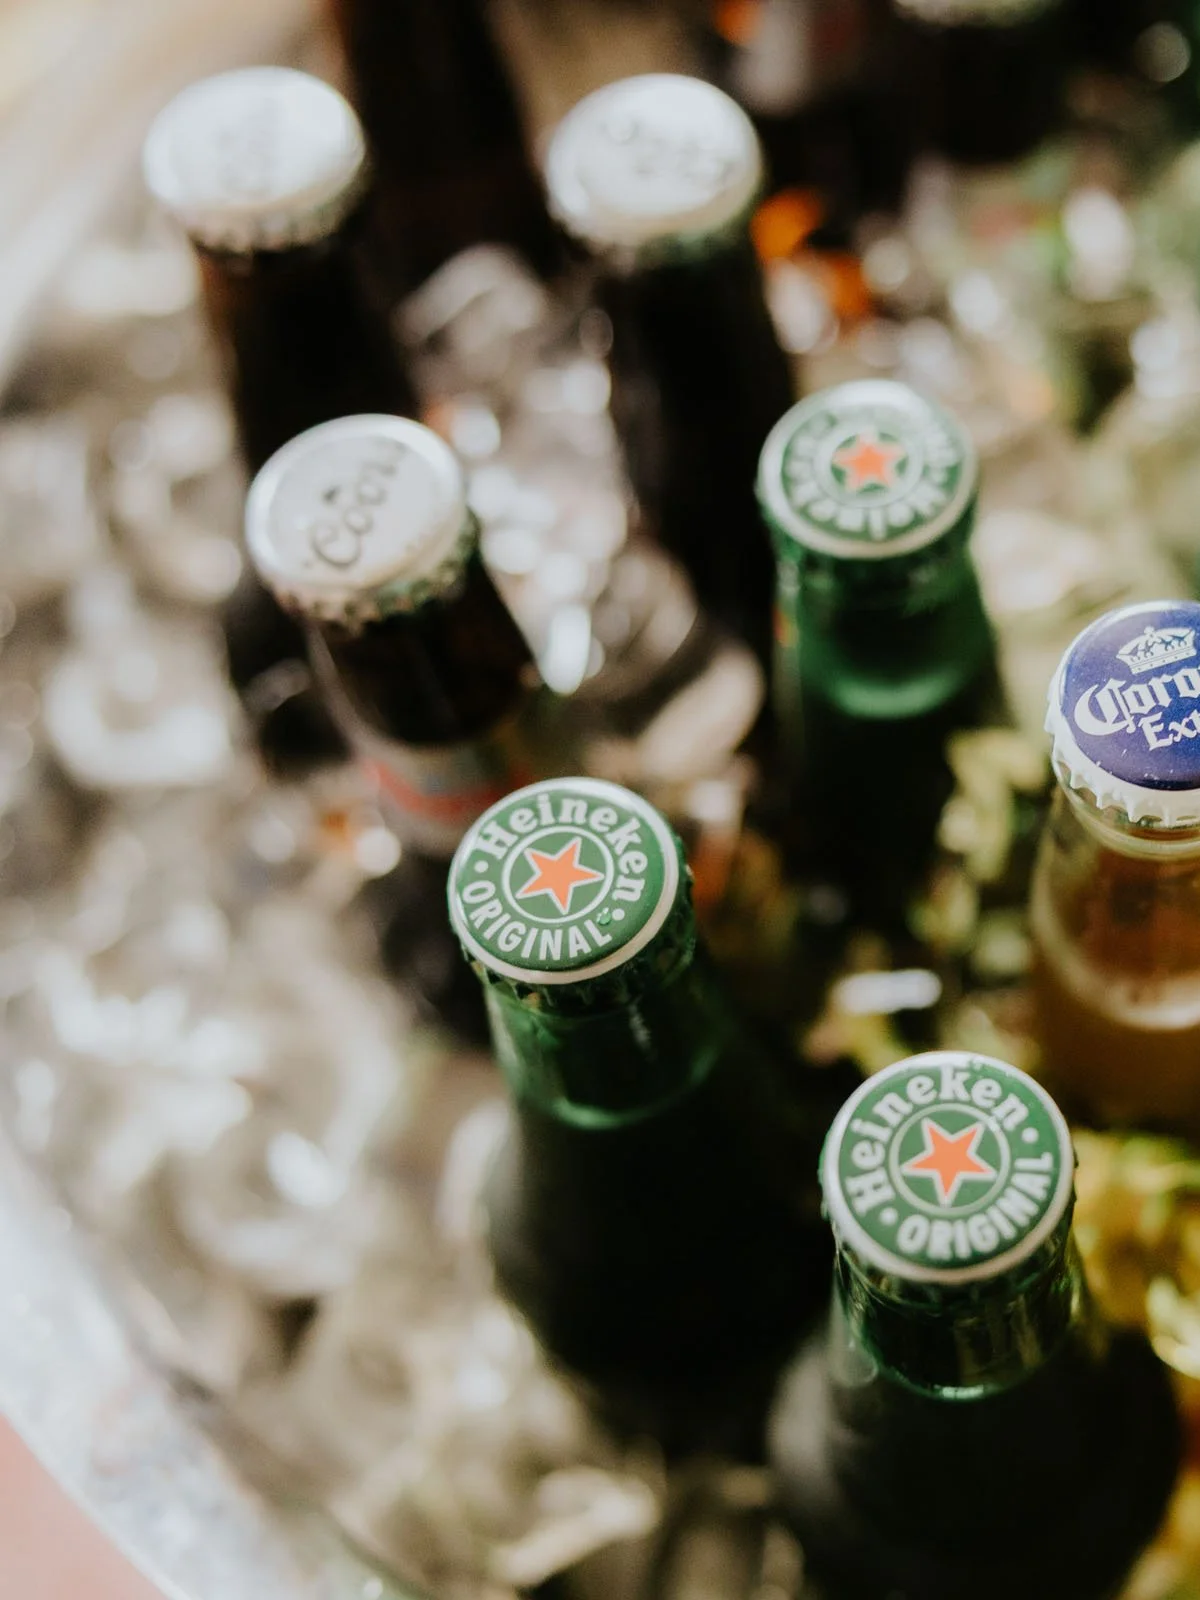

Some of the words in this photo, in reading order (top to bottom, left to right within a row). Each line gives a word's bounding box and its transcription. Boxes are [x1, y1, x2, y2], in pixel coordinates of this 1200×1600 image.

[474, 793, 648, 902] Heineken
[462, 879, 612, 961] ORIGINAL
[845, 1064, 1029, 1217] Heineken
[896, 1151, 1053, 1260] ORIGINAL
